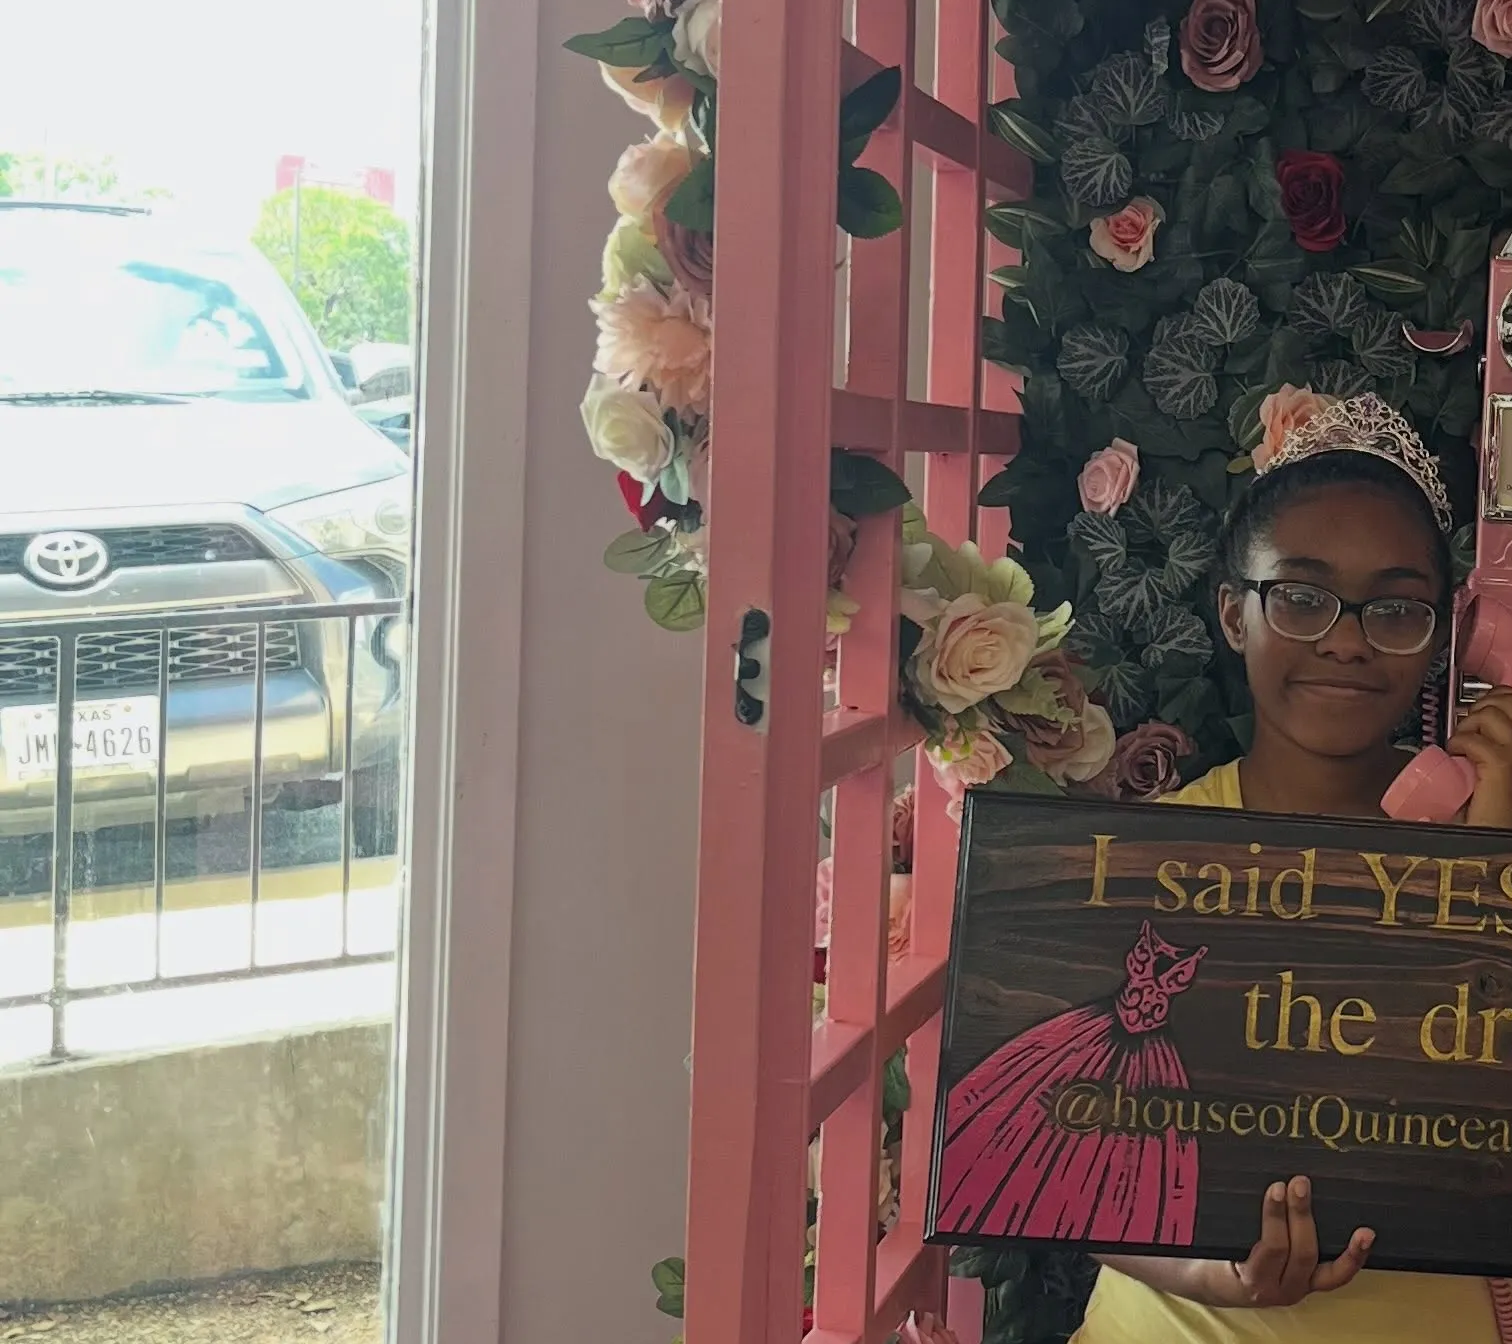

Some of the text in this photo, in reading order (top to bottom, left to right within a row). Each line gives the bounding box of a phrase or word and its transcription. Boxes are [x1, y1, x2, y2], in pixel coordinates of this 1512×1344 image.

[72, 709, 112, 722] XAS
[1083, 833, 1117, 908] I
[1154, 843, 1318, 921] said
[1243, 971, 1377, 1056] the
